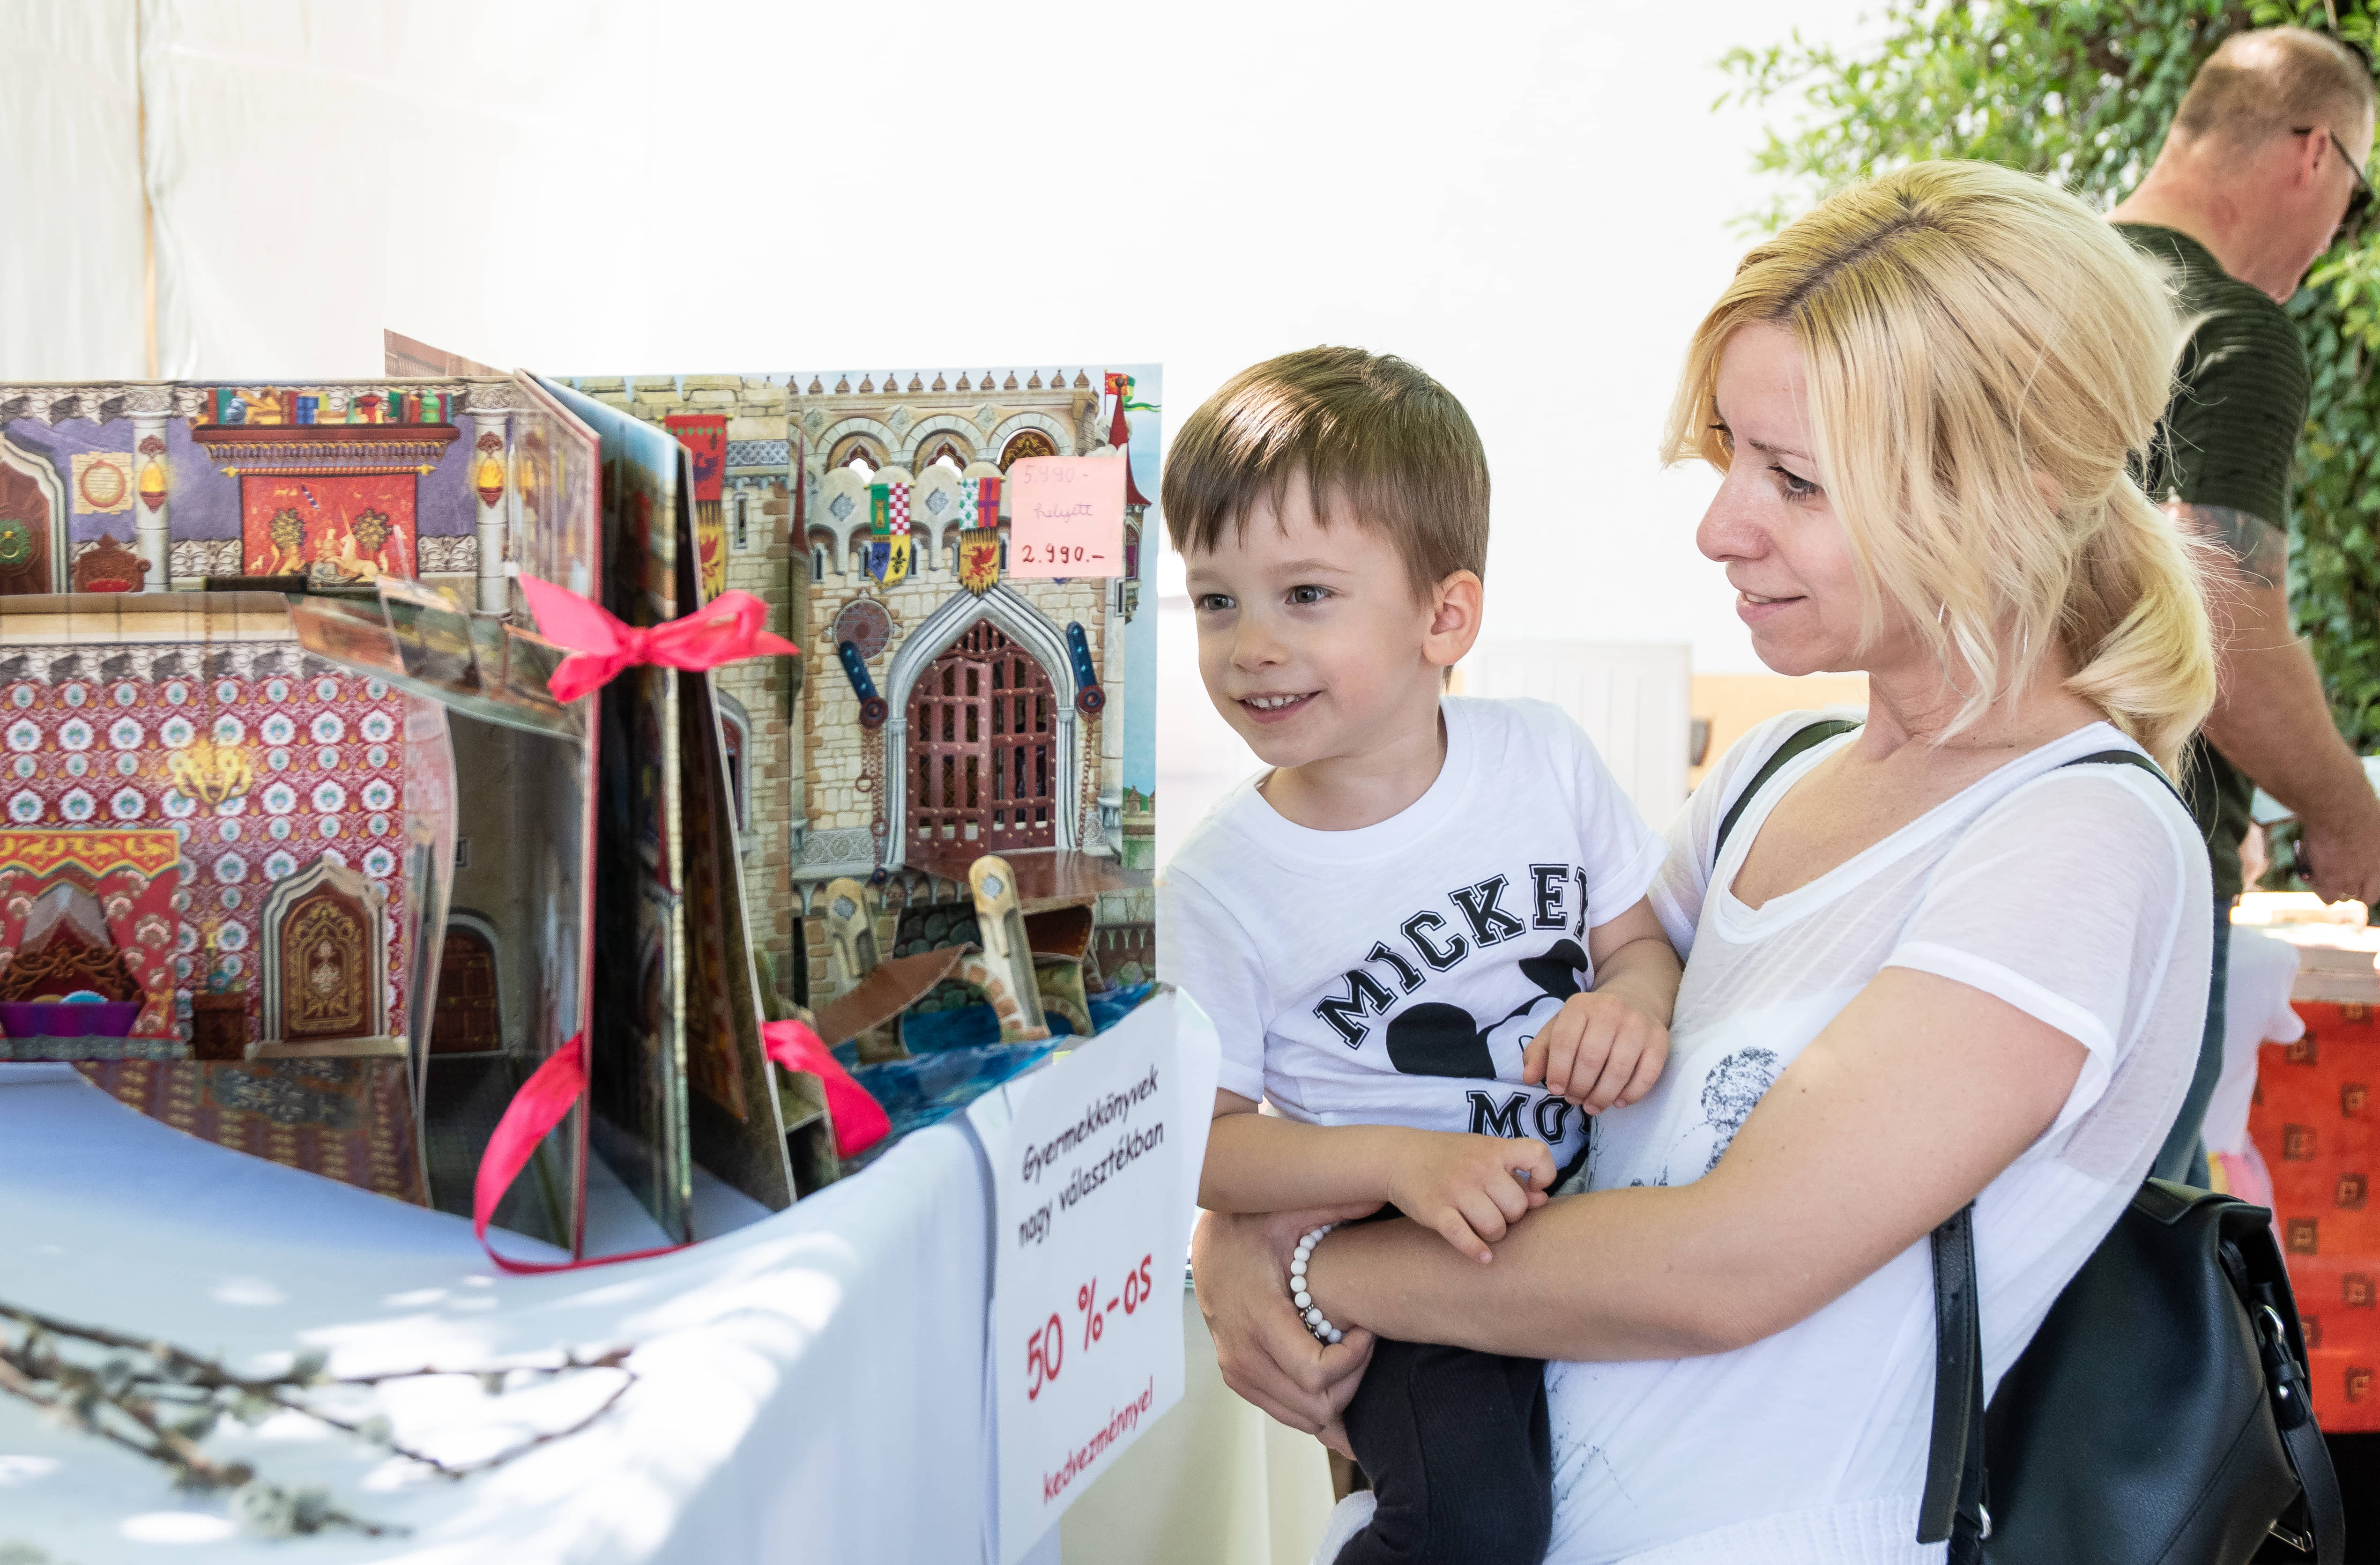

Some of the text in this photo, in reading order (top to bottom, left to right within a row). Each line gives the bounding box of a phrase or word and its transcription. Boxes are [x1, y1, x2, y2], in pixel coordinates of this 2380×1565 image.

[1022, 543, 1105, 564] 2.990.-
[1022, 1061, 1159, 1185] Gyermekkönyvek
[1019, 1122, 1165, 1250] nagy választékban
[1027, 1312, 1064, 1402] 50
[1043, 1373, 1153, 1506] kedvezménnyel
